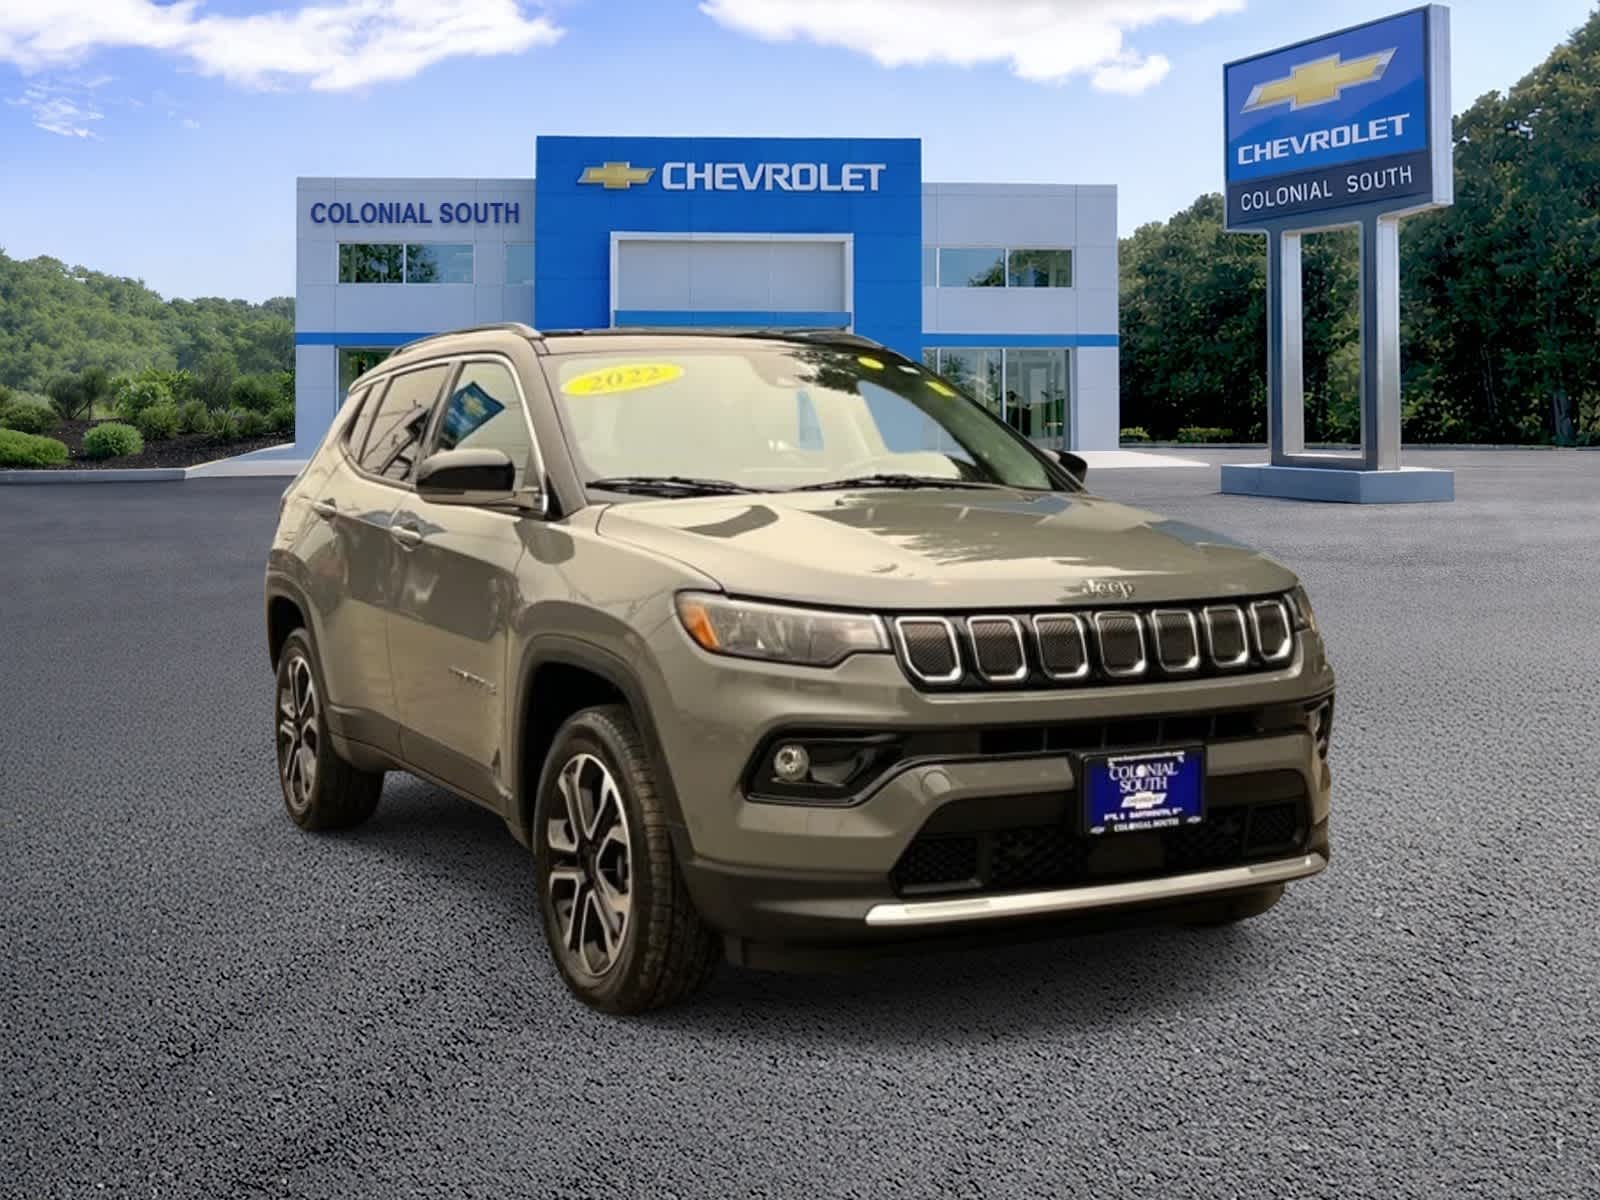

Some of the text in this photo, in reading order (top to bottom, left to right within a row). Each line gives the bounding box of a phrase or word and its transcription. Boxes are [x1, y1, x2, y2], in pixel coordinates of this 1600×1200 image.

[1237, 113, 1410, 165] CHEVROLET
[661, 161, 887, 192] CHEVROLET
[1240, 165, 1413, 211] COLONIAL SOUTH
[310, 202, 520, 225] COLONIAL SOUTH
[591, 366, 662, 391] 2022
[1082, 579, 1135, 599] Jeep
[1108, 762, 1179, 782] COLONIAL
[1119, 776, 1168, 793] SOUTH
